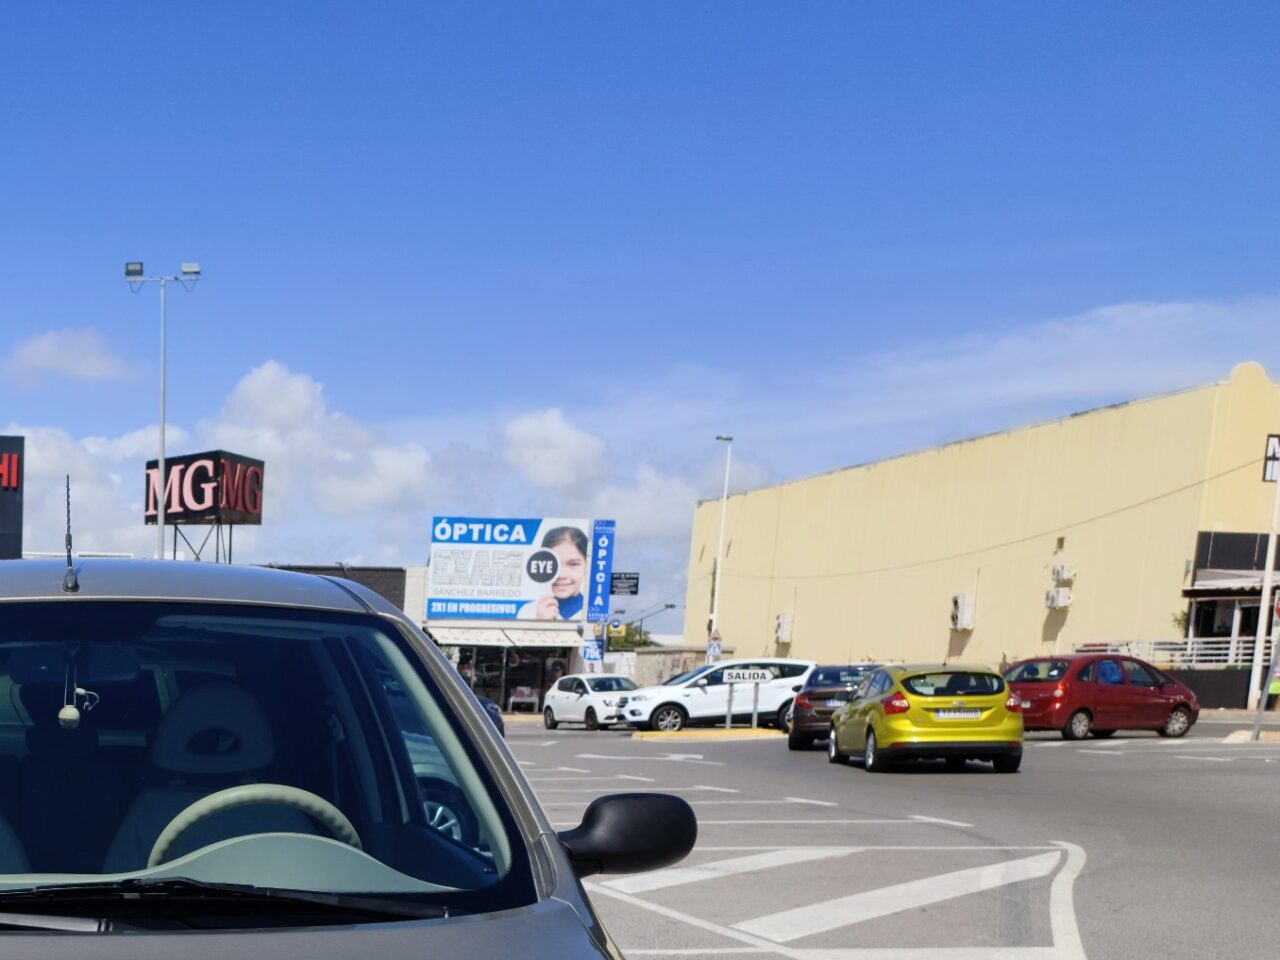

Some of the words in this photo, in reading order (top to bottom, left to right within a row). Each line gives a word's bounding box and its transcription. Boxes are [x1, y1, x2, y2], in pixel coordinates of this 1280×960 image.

[145, 459, 217, 515] MG
[220, 459, 261, 514] MG
[434, 519, 527, 542] ÓPTICA
[530, 560, 554, 573] EYE
[459, 603, 517, 614] PROGRESIVOS
[727, 672, 767, 680] SALIDA
